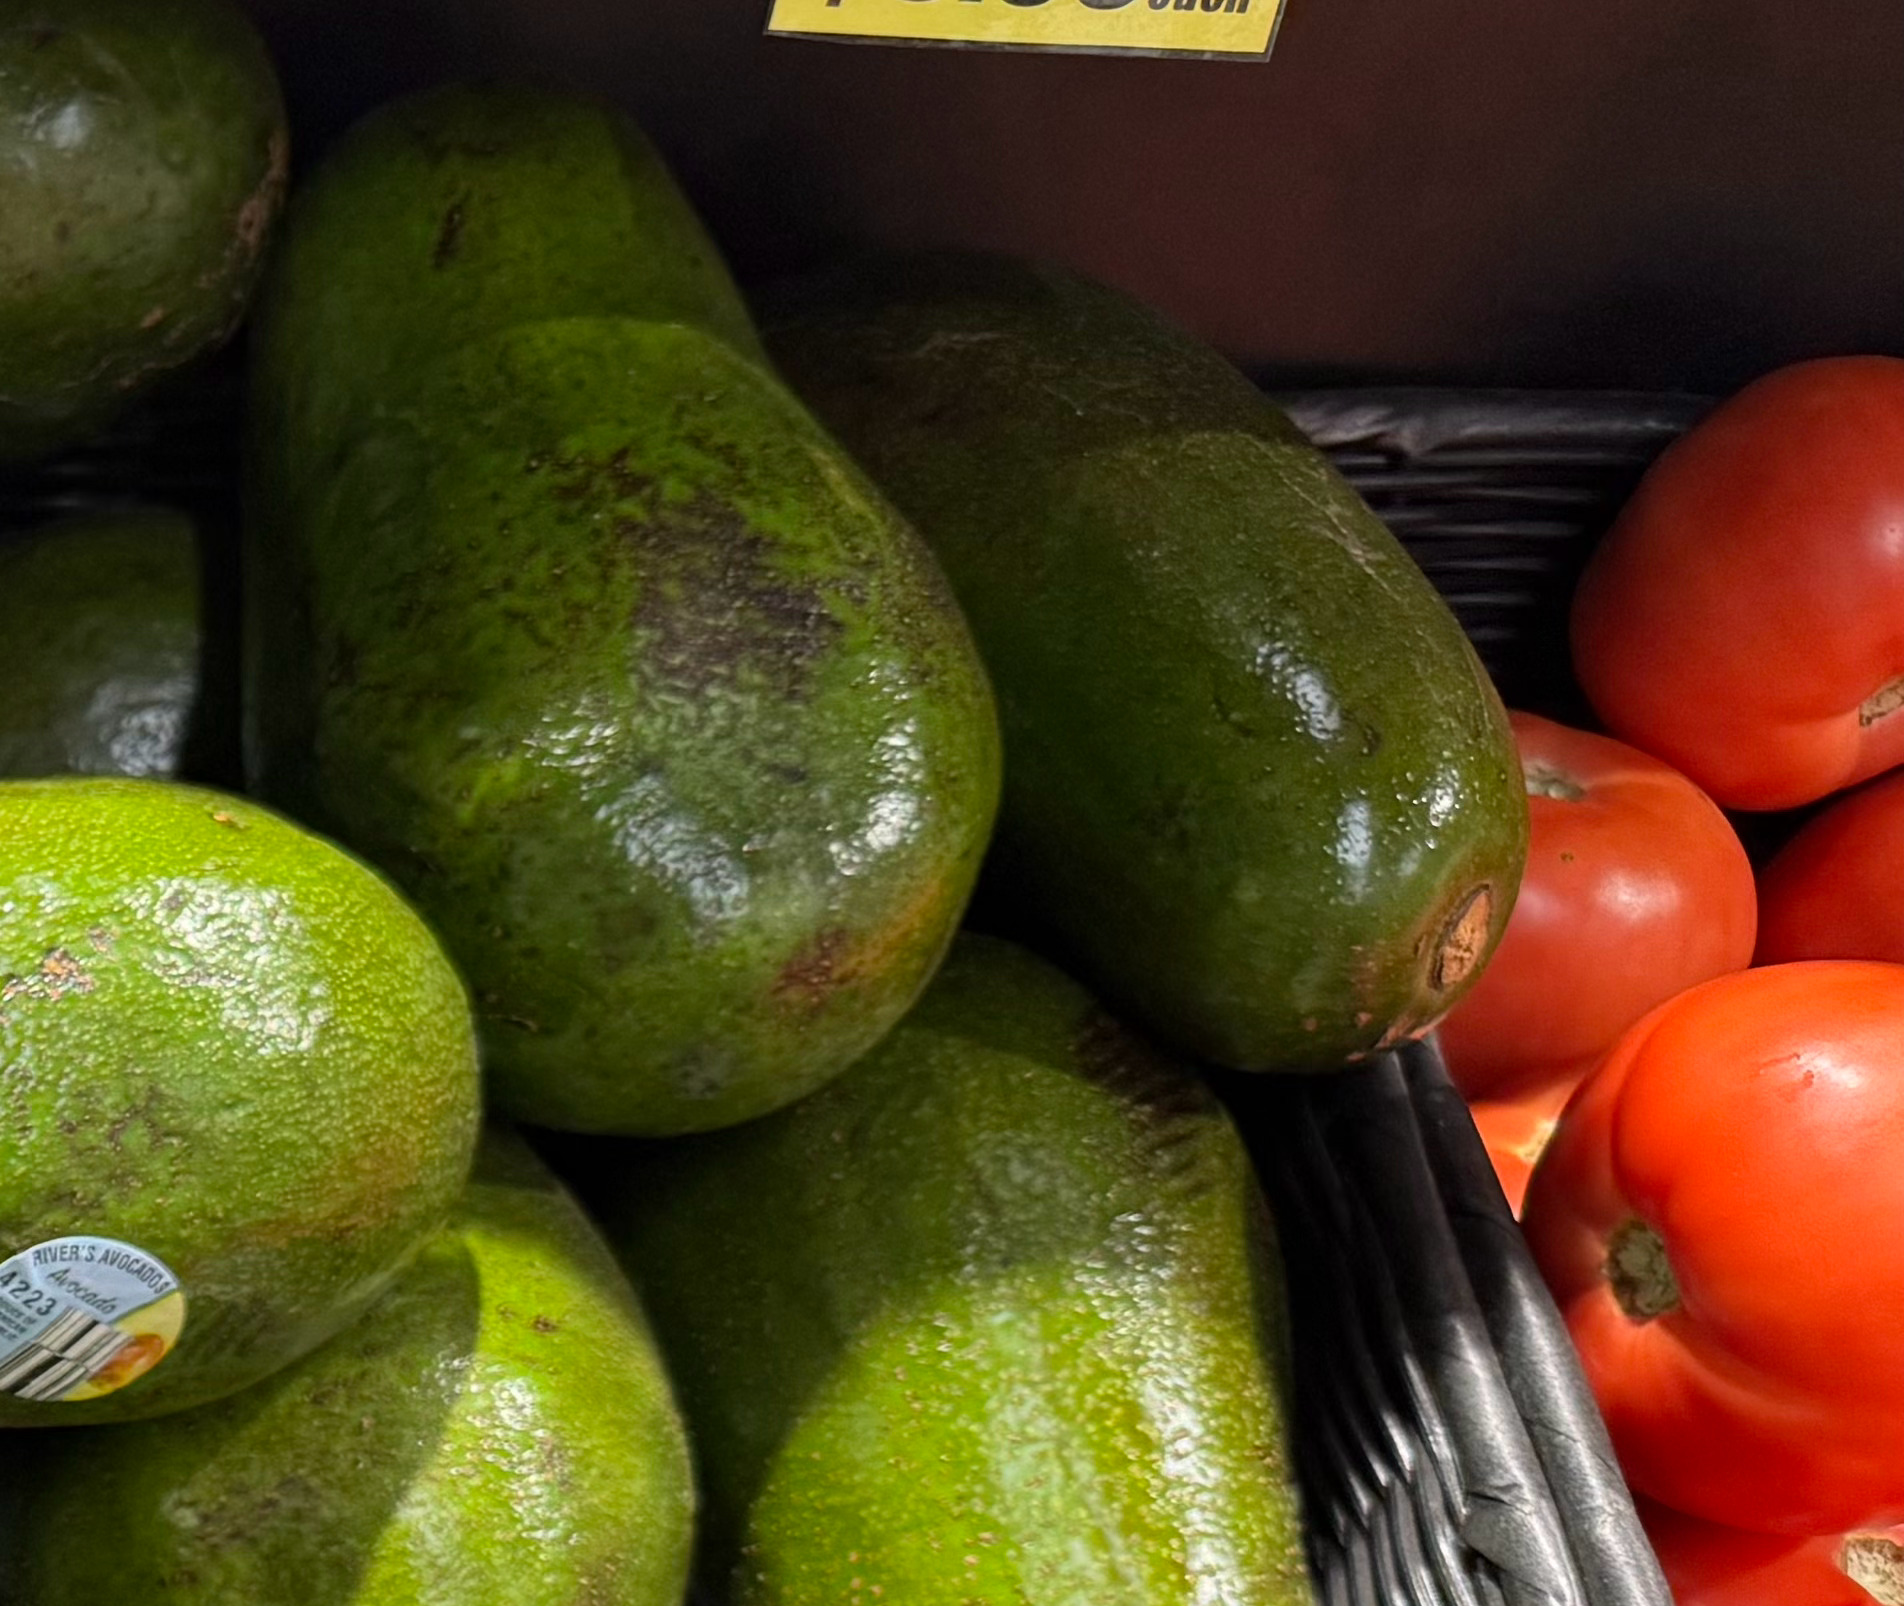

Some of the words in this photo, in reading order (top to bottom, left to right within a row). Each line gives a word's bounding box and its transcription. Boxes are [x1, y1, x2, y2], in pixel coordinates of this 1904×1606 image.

[32, 1245, 95, 1267] RIVER'S
[98, 1248, 172, 1295] AVOCADOS
[47, 1268, 117, 1314] Avocado
